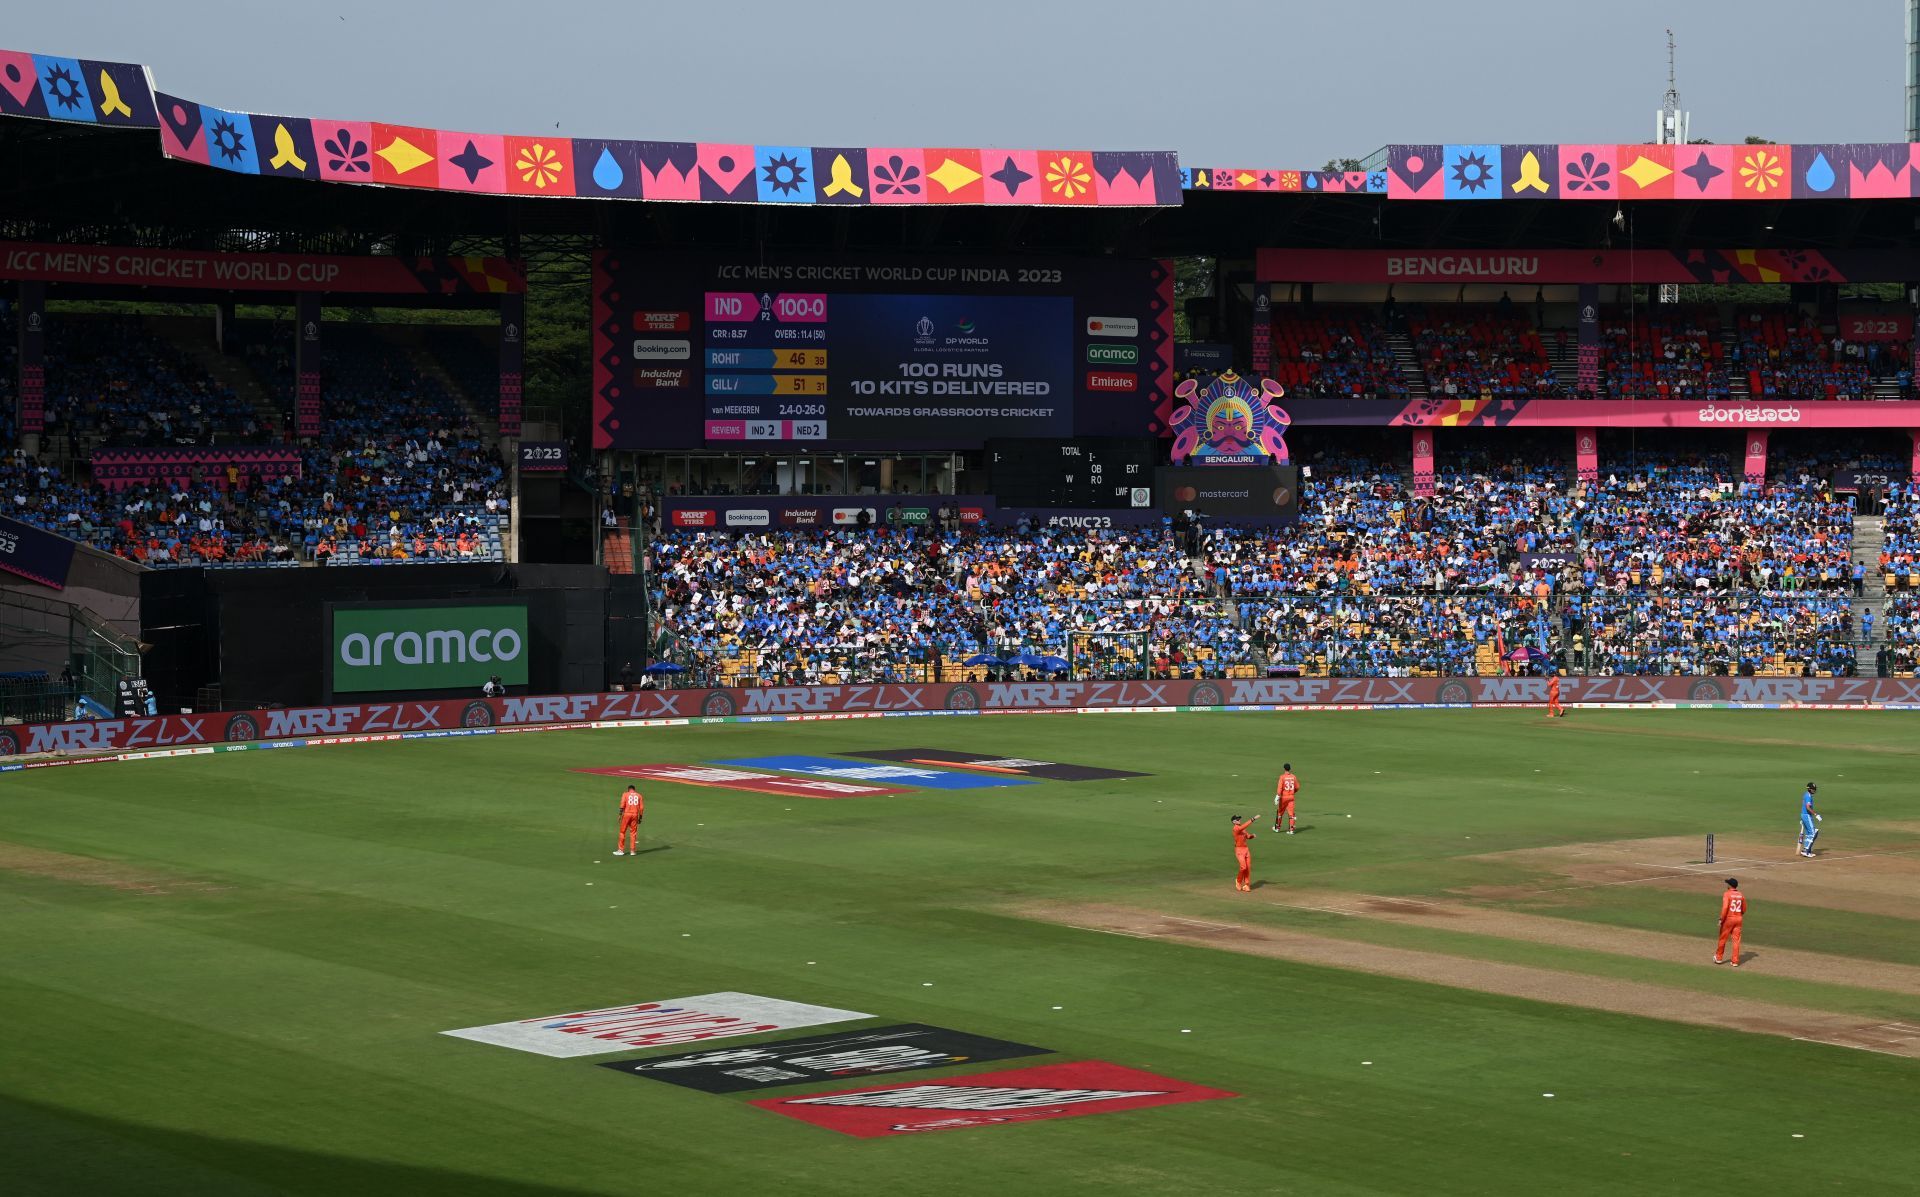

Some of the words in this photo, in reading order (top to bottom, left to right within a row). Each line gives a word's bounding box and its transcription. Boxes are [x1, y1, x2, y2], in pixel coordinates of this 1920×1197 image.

[6, 250, 39, 270] ICC
[44, 253, 110, 273] MEN'S
[115, 256, 207, 279] CRICKET
[213, 261, 291, 281] WORLD
[297, 263, 339, 281] CUP
[1387, 256, 1538, 276] BENGALURU
[718, 266, 741, 279] ICC
[745, 266, 793, 280] MEN'S
[796, 266, 861, 280] CRICKET
[865, 267, 922, 281] WORLD
[926, 268, 957, 282] CUP
[961, 268, 1010, 283] INDIA
[1018, 269, 1062, 284] 2023
[714, 298, 742, 315] IND
[778, 298, 824, 315] 100-0
[644, 313, 679, 322] MRF
[761, 312, 770, 321] P2
[731, 330, 747, 338] 8.57
[775, 330, 796, 339] OVERS
[800, 330, 812, 339] 11.4
[813, 330, 826, 340] (50)
[637, 345, 687, 354] Booking.com
[1089, 349, 1136, 360] aramco
[712, 352, 740, 365] ROHIT
[789, 352, 805, 365] 46
[815, 356, 824, 365] 39
[640, 369, 682, 378] IndusInd
[898, 363, 938, 377] 100
[942, 363, 1003, 378] RUNS
[655, 378, 680, 387] Bank
[793, 378, 805, 391] 51
[816, 382, 825, 391] 31
[1091, 376, 1133, 388] Emirates
[850, 381, 875, 395] 10
[880, 381, 928, 395] KITS
[932, 381, 1050, 395] DELIVERED
[712, 407, 724, 415] van
[724, 406, 760, 415] MEEKEREN
[779, 405, 825, 415] 2.4-0-26-0
[847, 407, 911, 417] TOWARDS
[912, 408, 999, 417] GRASSROOTS
[1000, 408, 1054, 417] CRICKET
[1698, 404, 1801, 422] ಬೆಂಗಳೂರು
[711, 426, 740, 435] REVIEWS
[751, 425, 765, 436] IND
[768, 424, 775, 436] 2
[796, 425, 812, 436] NED
[813, 424, 820, 436] 2
[1061, 446, 1082, 456] TOTAL
[1205, 455, 1254, 464] BENGALURU
[1091, 464, 1102, 473] OB
[1126, 464, 1139, 474] EXT
[1066, 475, 1074, 483] W
[1115, 487, 1128, 496] LWF
[1199, 489, 1249, 498] mastercard
[680, 511, 708, 519] MRF
[728, 514, 767, 522] Booking.com
[784, 509, 817, 517] IndusInd
[1049, 516, 1112, 528] #CWC23
[7, 533, 19, 541] CUP
[341, 628, 521, 666] aramco
[986, 682, 1084, 707] MRF
[1086, 683, 1167, 706] ZLX
[1230, 679, 1330, 703] MRF
[1331, 679, 1415, 702] ZLX
[1582, 678, 1667, 700] ZLX
[1730, 678, 1835, 702] MRF
[742, 687, 841, 713] MRF
[843, 686, 924, 710] ZLX
[500, 695, 598, 723] MRF
[600, 694, 680, 718] ZLX
[265, 706, 360, 736] MRF
[363, 704, 441, 731] ZLX
[26, 721, 125, 753] MRF
[126, 718, 206, 746] ZLX
[1284, 780, 1295, 791] 35
[628, 795, 639, 806] 88
[1730, 900, 1742, 912] 52
